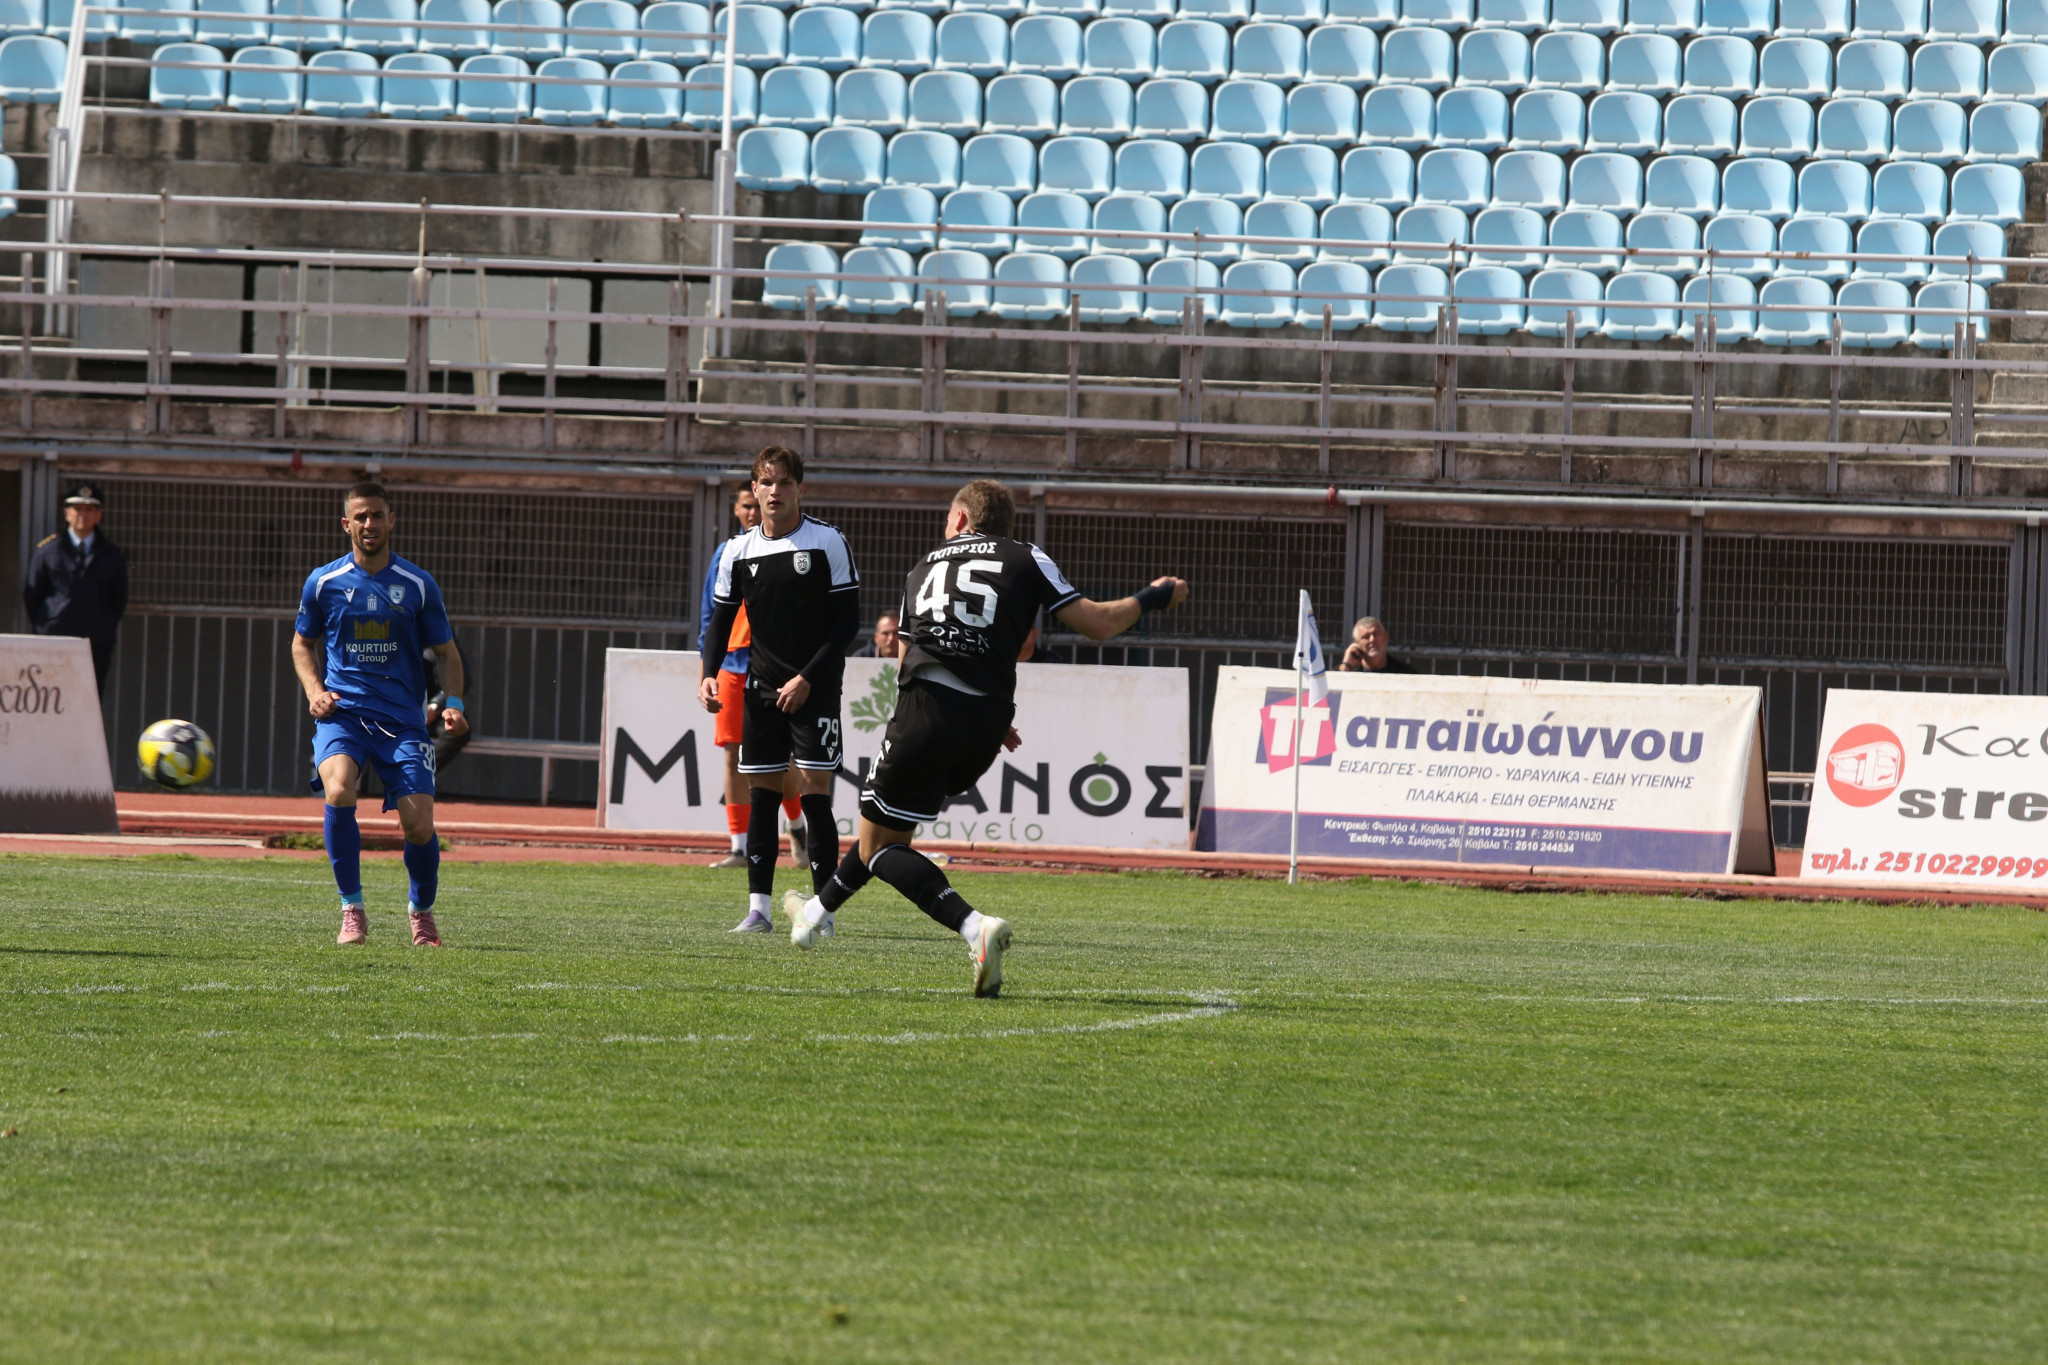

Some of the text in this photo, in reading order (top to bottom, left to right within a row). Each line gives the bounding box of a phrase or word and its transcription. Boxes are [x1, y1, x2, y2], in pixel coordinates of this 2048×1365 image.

[915, 559, 1004, 629] 45
[345, 641, 398, 654] KOURTIDIS
[357, 653, 388, 664] Group
[817, 717, 840, 747] 79
[1338, 760, 1695, 790] ΕΙΣΑΓΩΓΕΣ ΕΜΠΟΡΙΟ ΥΔΡΑΥΛΙΚΑ ΕΙΔΗ ΥΓΙΕΙΝΗΣ
[1405, 788, 1618, 812] ΠΛΑΚΑΚΙΑ ΕΙΔΗ ΘΕΡΜΑΝΣΗΣ
[1467, 825, 1492, 837] 2510
[1514, 840, 1539, 852] 2510
